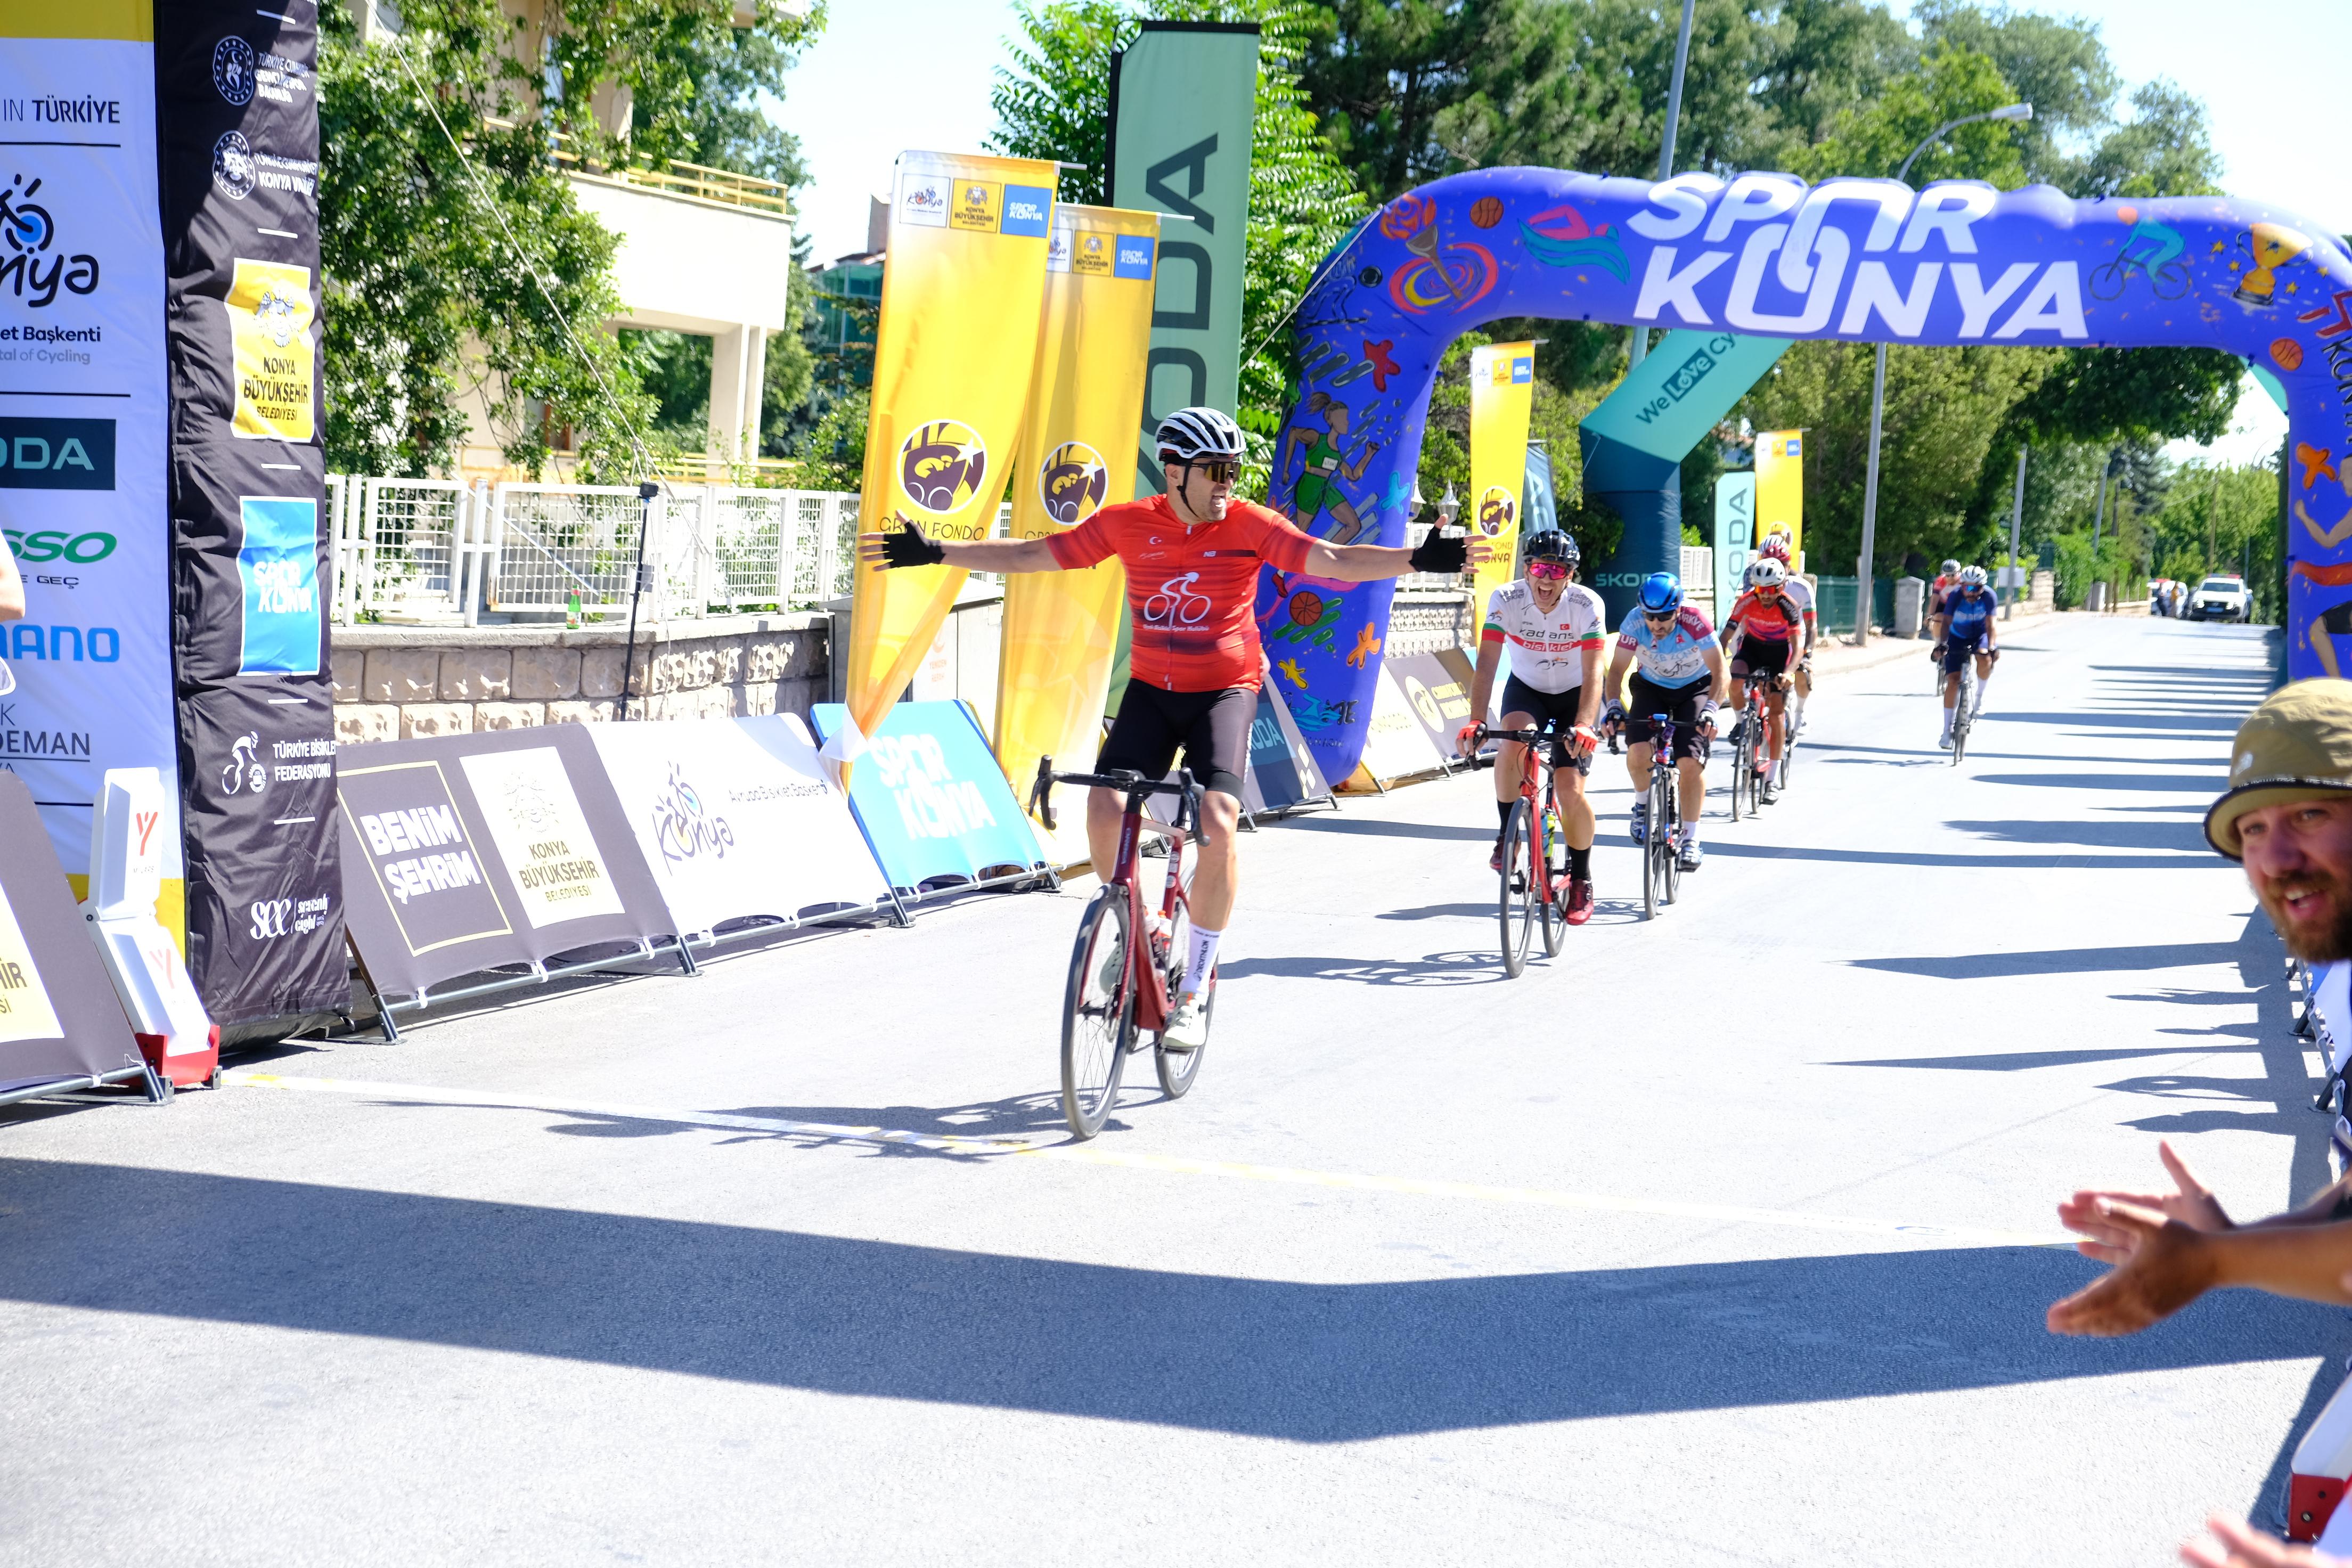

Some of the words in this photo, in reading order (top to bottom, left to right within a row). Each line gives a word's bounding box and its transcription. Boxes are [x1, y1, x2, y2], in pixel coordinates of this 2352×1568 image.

[4, 99, 23, 121] IN
[32, 94, 120, 124] TÜRKİYE
[1009, 202, 1038, 211] SPOR
[1009, 208, 1043, 221] KONYA
[1626, 173, 1997, 261] SPOR
[1121, 255, 1148, 266] KONYA
[1633, 232, 2088, 339] KONYA
[23, 326, 101, 344] Başkenti
[20, 349, 34, 361] of
[37, 349, 91, 365] Cycling
[264, 357, 296, 376] KONYA
[243, 374, 308, 406] BÜYÜKŞEHİR
[1636, 396, 1671, 424] We
[1667, 356, 1712, 396] Love
[0, 437, 95, 470] DA
[880, 517, 927, 535] GRN
[932, 522, 984, 541] FONDO
[37, 576, 79, 589] GEÇ
[253, 560, 302, 587] SPOR
[258, 585, 313, 614] KONYA
[0, 624, 120, 663] ANO
[0, 730, 91, 756] EMAN
[272, 739, 310, 759] TÜRKİYE
[274, 763, 331, 782] FEDERASYONU
[868, 733, 953, 788] SPOR
[892, 775, 998, 840] KONYA
[360, 804, 463, 857] BENİM
[528, 840, 570, 860] KONYA
[384, 851, 481, 905] ŞEHRİM
